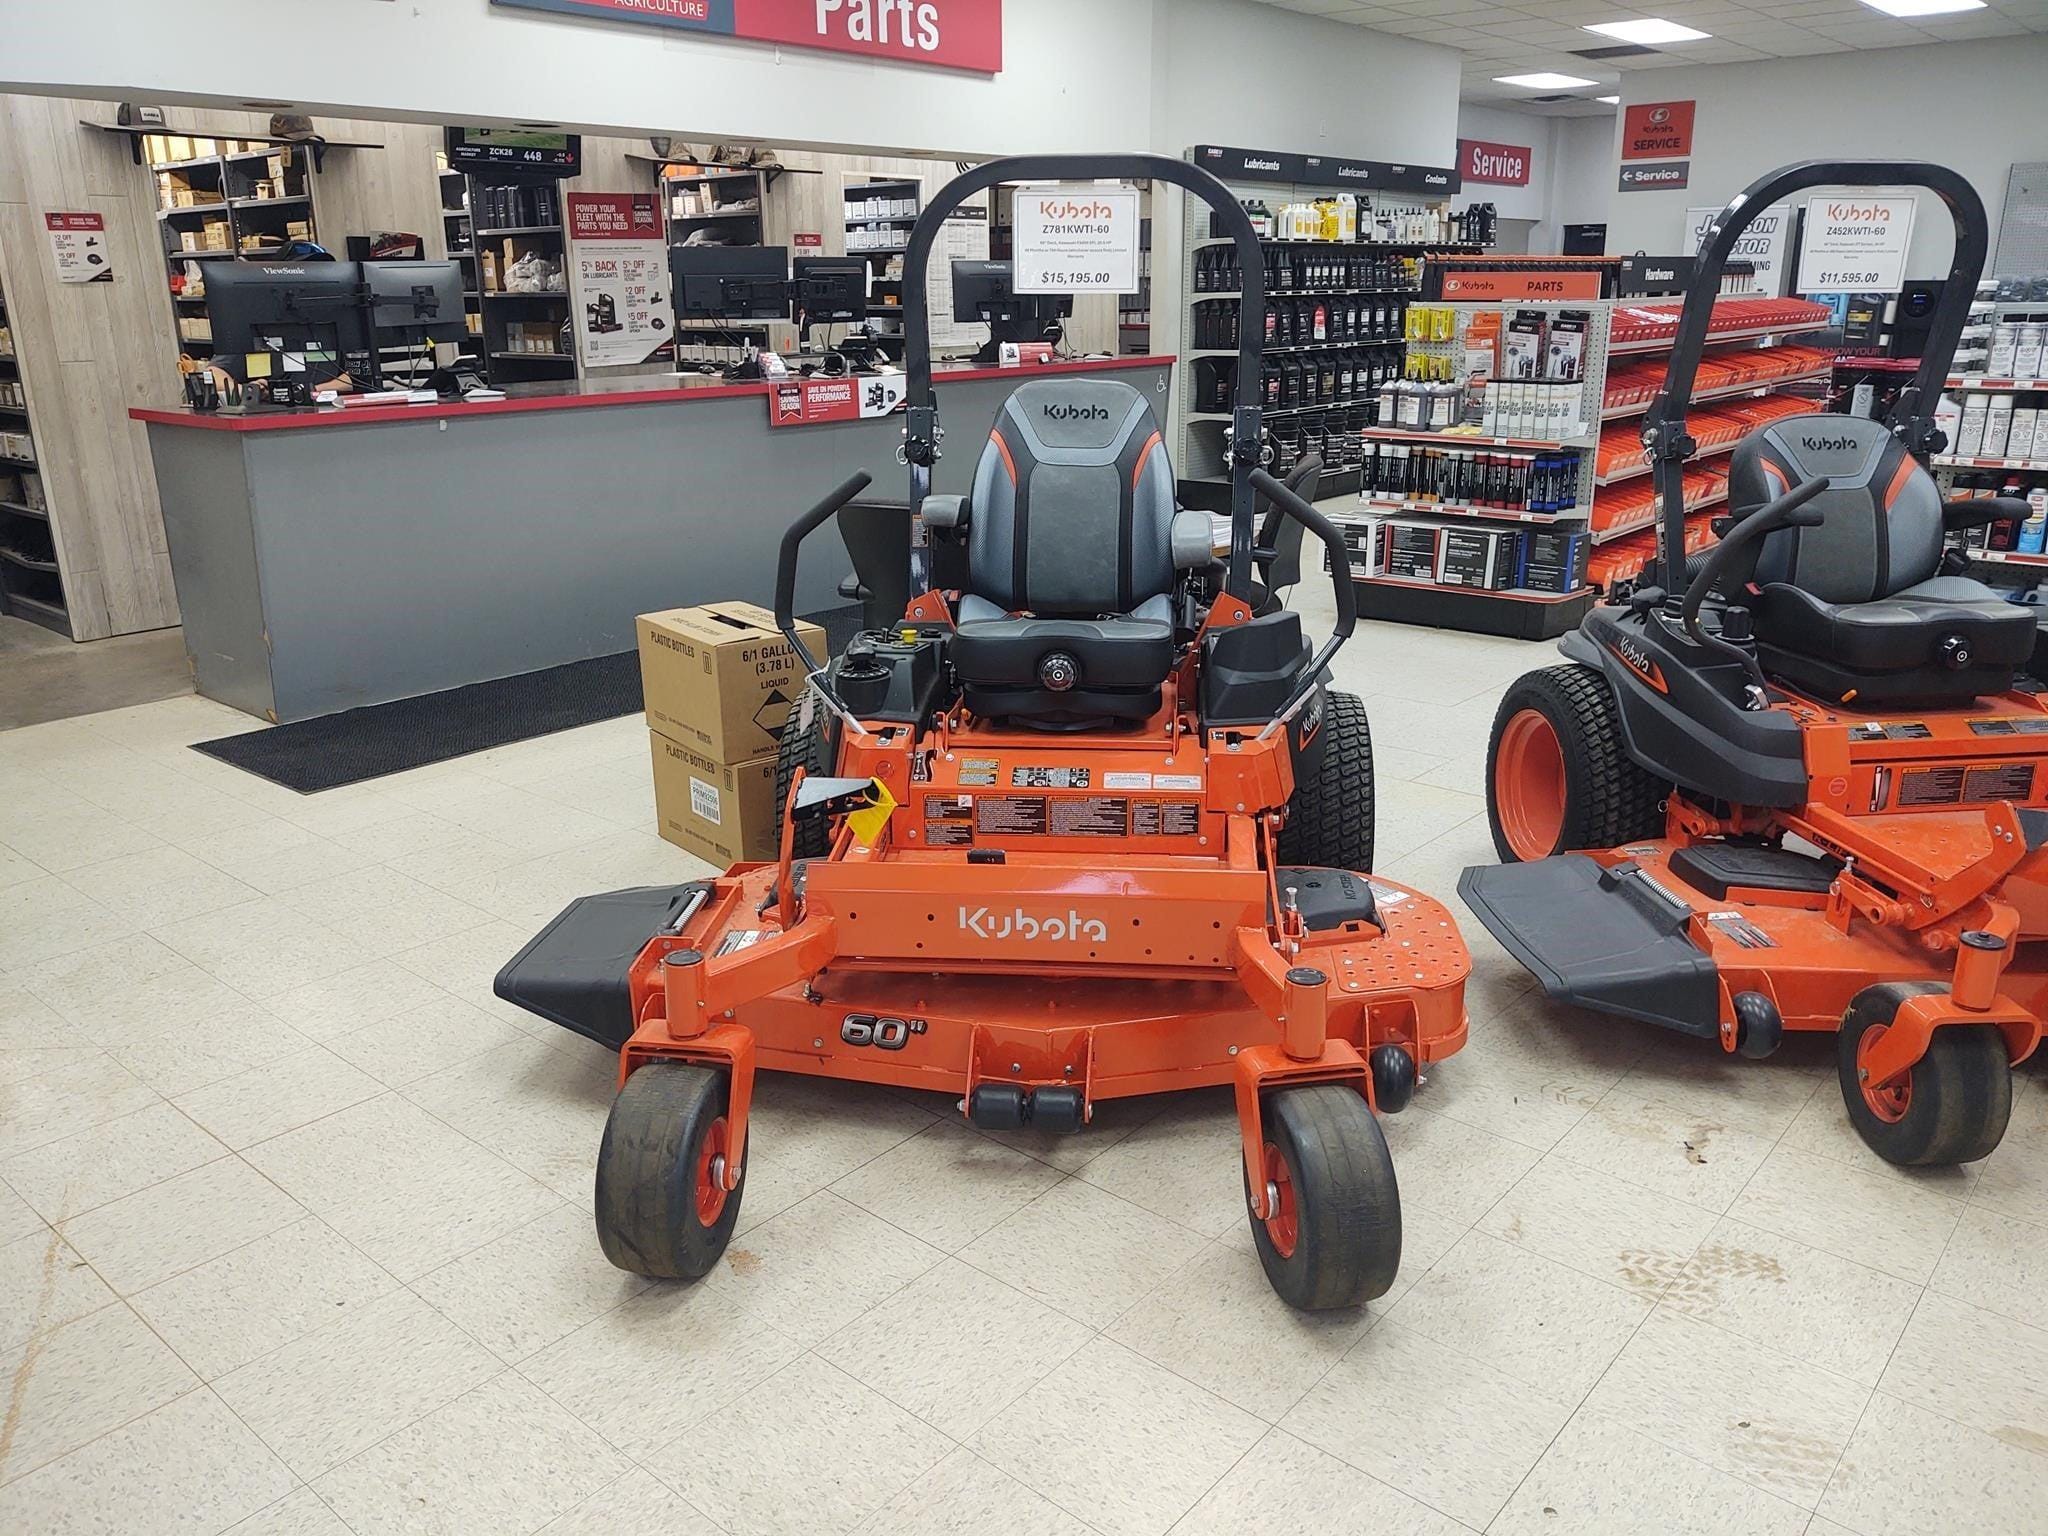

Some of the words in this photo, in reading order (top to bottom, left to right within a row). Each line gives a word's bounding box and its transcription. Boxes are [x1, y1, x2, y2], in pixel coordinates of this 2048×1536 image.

[816, 0, 939, 50] Parts
[1643, 125, 1673, 133] Kubota
[1633, 138, 1680, 150] SERVICE
[524, 151, 542, 161] 448
[1244, 158, 1280, 171] Lubricants
[1472, 149, 1522, 179] Service
[1338, 167, 1368, 178] Lubricants
[1635, 170, 1679, 181] Service
[1425, 174, 1448, 184] Coolants
[575, 204, 598, 212] POWER
[1040, 201, 1112, 219] Kubota
[1828, 204, 1890, 221] Kubota
[576, 213, 594, 221] FLEET
[595, 213, 611, 221] WITH
[614, 213, 625, 221] THE
[577, 222, 597, 230] PARTS
[613, 222, 628, 230] NEED
[1042, 225, 1109, 234] Z781KWTI-60
[1695, 215, 1778, 234] JSON
[1826, 226, 1885, 236] Z452KWTI-60
[1696, 235, 1770, 256] TCTOR
[263, 267, 305, 275] ViewSonic
[595, 261, 617, 271] BACK
[1042, 271, 1110, 284] $15,195.00
[1645, 268, 1674, 280] Hardware
[1820, 272, 1879, 284] $11,595.00
[634, 286, 646, 294] OFF
[1462, 280, 1494, 290] Kubota
[1528, 281, 1563, 292] PARTS
[637, 312, 648, 320] OFF
[808, 391, 851, 402] PERFORMANCE
[1044, 404, 1109, 420] Kubota
[1802, 436, 1858, 451] Kubota
[651, 631, 671, 648] PLASTIC
[672, 639, 694, 658] BOTTLES
[743, 649, 757, 662] 6/1
[762, 644, 794, 659] GALLO
[1620, 636, 1649, 672] Kubota
[756, 659, 781, 676] (3.78
[785, 657, 794, 670] L)
[761, 677, 789, 689] LIQUID
[1302, 704, 1322, 732] Kubota
[666, 744, 688, 763] PLASTIC
[690, 755, 715, 774] BOTTLES
[763, 766, 777, 778] 6/1
[959, 906, 1107, 942] Kubota
[841, 1013, 928, 1051] 60"
